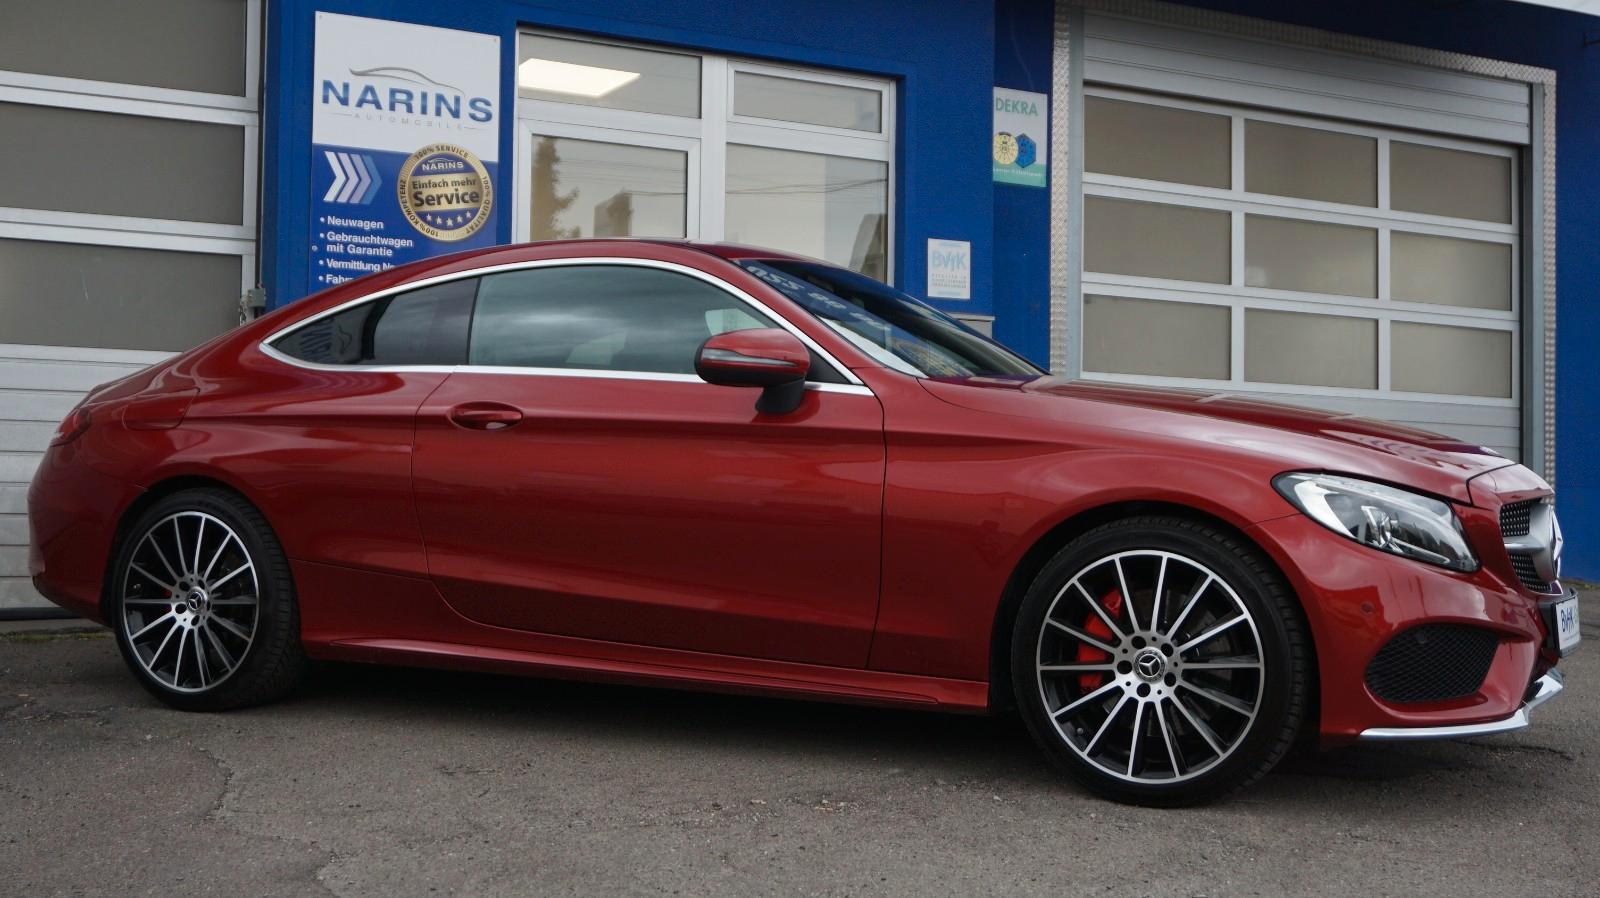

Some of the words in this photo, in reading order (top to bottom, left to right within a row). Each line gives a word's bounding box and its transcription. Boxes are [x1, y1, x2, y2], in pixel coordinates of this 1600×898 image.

[322, 79, 493, 122] NARINS
[995, 97, 1039, 116] DEKRA
[354, 113, 464, 130] AUTOMOBILE
[414, 146, 435, 159] 100%
[435, 145, 469, 158] SERVICE
[422, 161, 464, 171] NARINS
[412, 179, 448, 189] Einfach
[451, 177, 477, 187] mehr
[399, 179, 419, 226] KOMPETENZ
[413, 188, 480, 207] Service
[327, 215, 384, 230] Neuwagen
[326, 231, 413, 248] Gebrauchtwagen
[326, 243, 344, 253] mit
[347, 244, 393, 256] Garantie
[326, 258, 381, 272] Vermittlung
